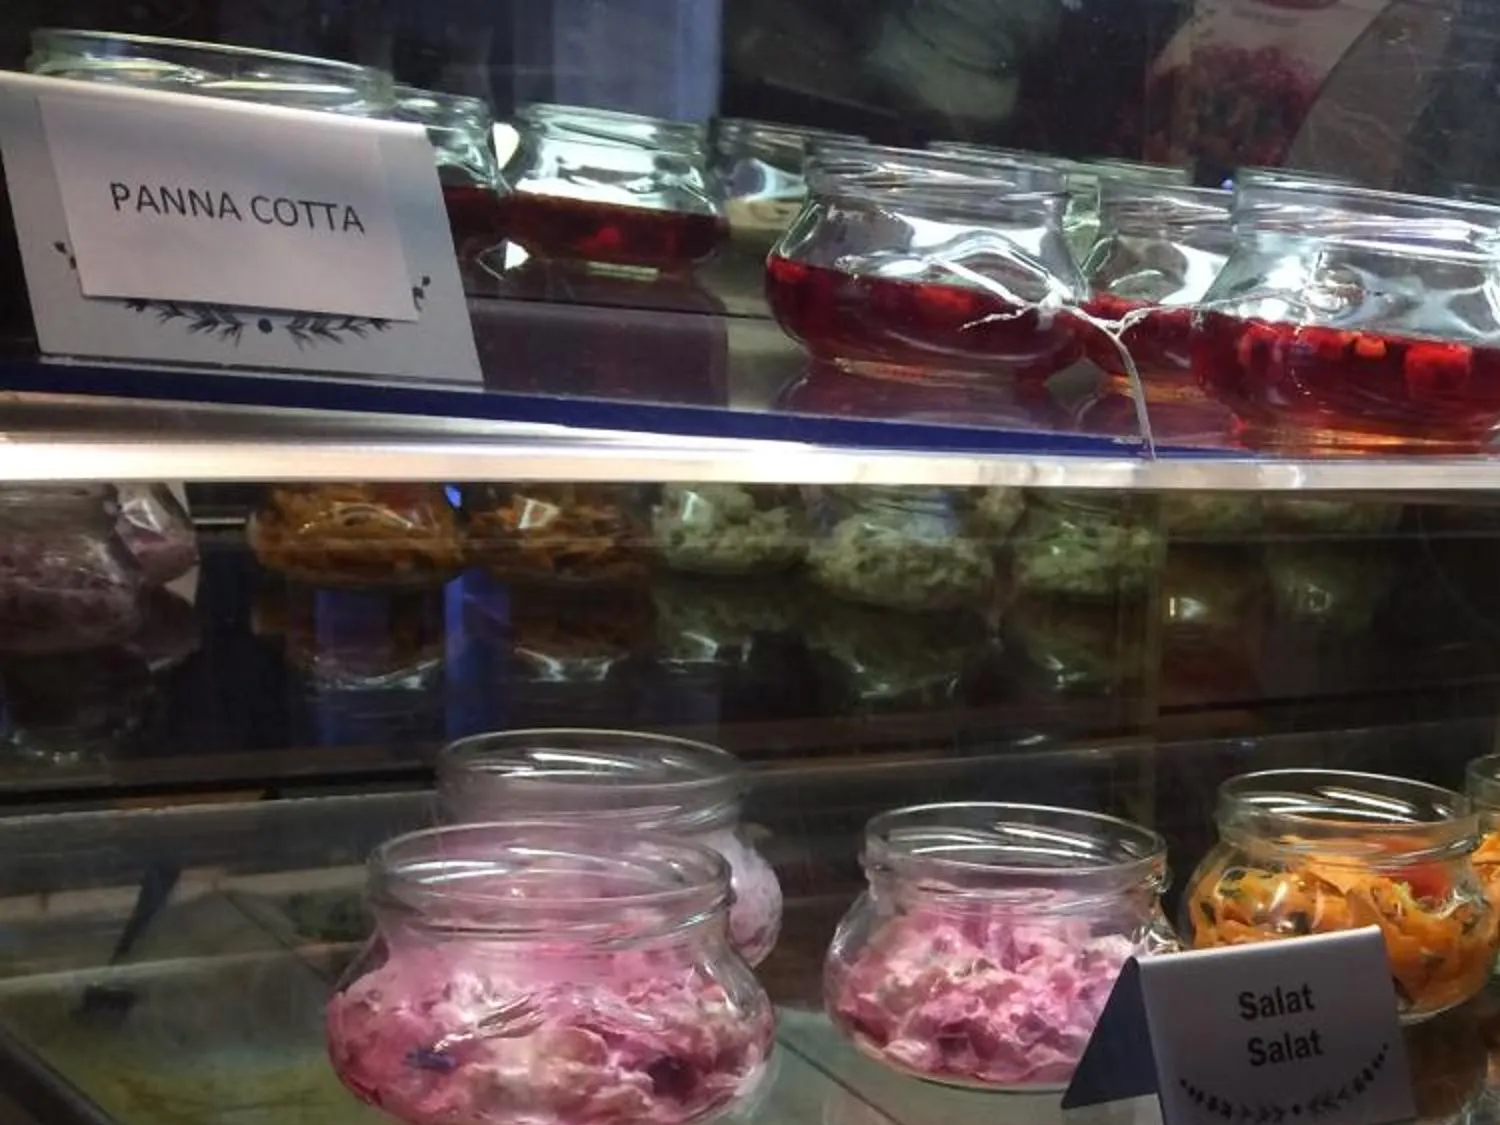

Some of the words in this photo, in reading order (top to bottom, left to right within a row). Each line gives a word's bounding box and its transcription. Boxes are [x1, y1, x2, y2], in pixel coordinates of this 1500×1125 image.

[110, 182, 242, 222] PANNA
[250, 195, 366, 234] COTTA
[1238, 983, 1316, 1021] Salat
[1247, 1029, 1324, 1068] Salat
